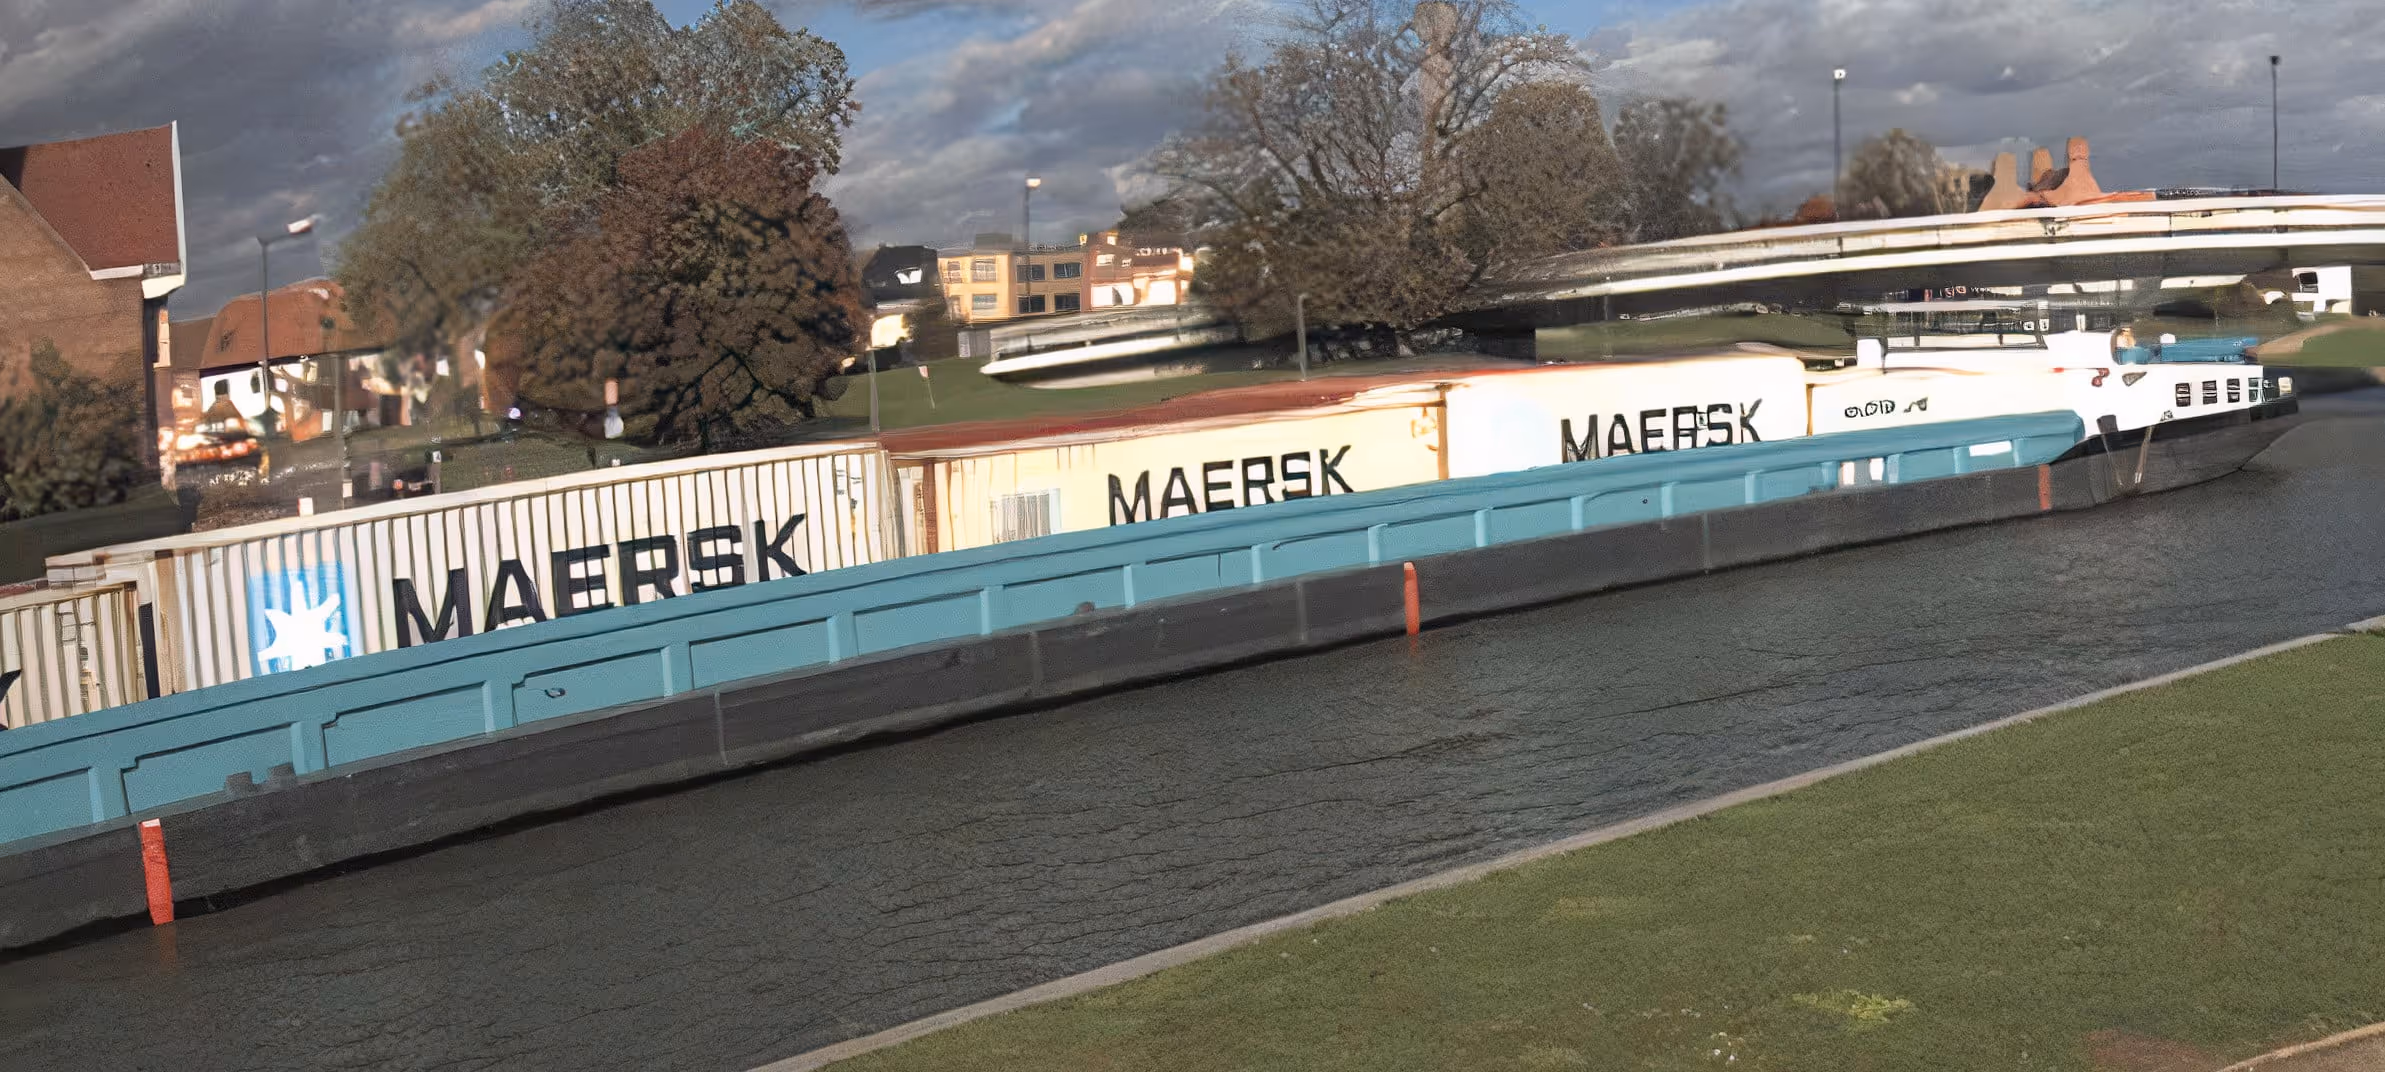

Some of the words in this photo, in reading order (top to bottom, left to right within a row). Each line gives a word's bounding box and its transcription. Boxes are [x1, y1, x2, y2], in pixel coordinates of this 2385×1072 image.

[1560, 398, 1763, 464] MAERSK
[1108, 445, 1353, 527] MAERSK
[393, 514, 807, 648] MAERSK
